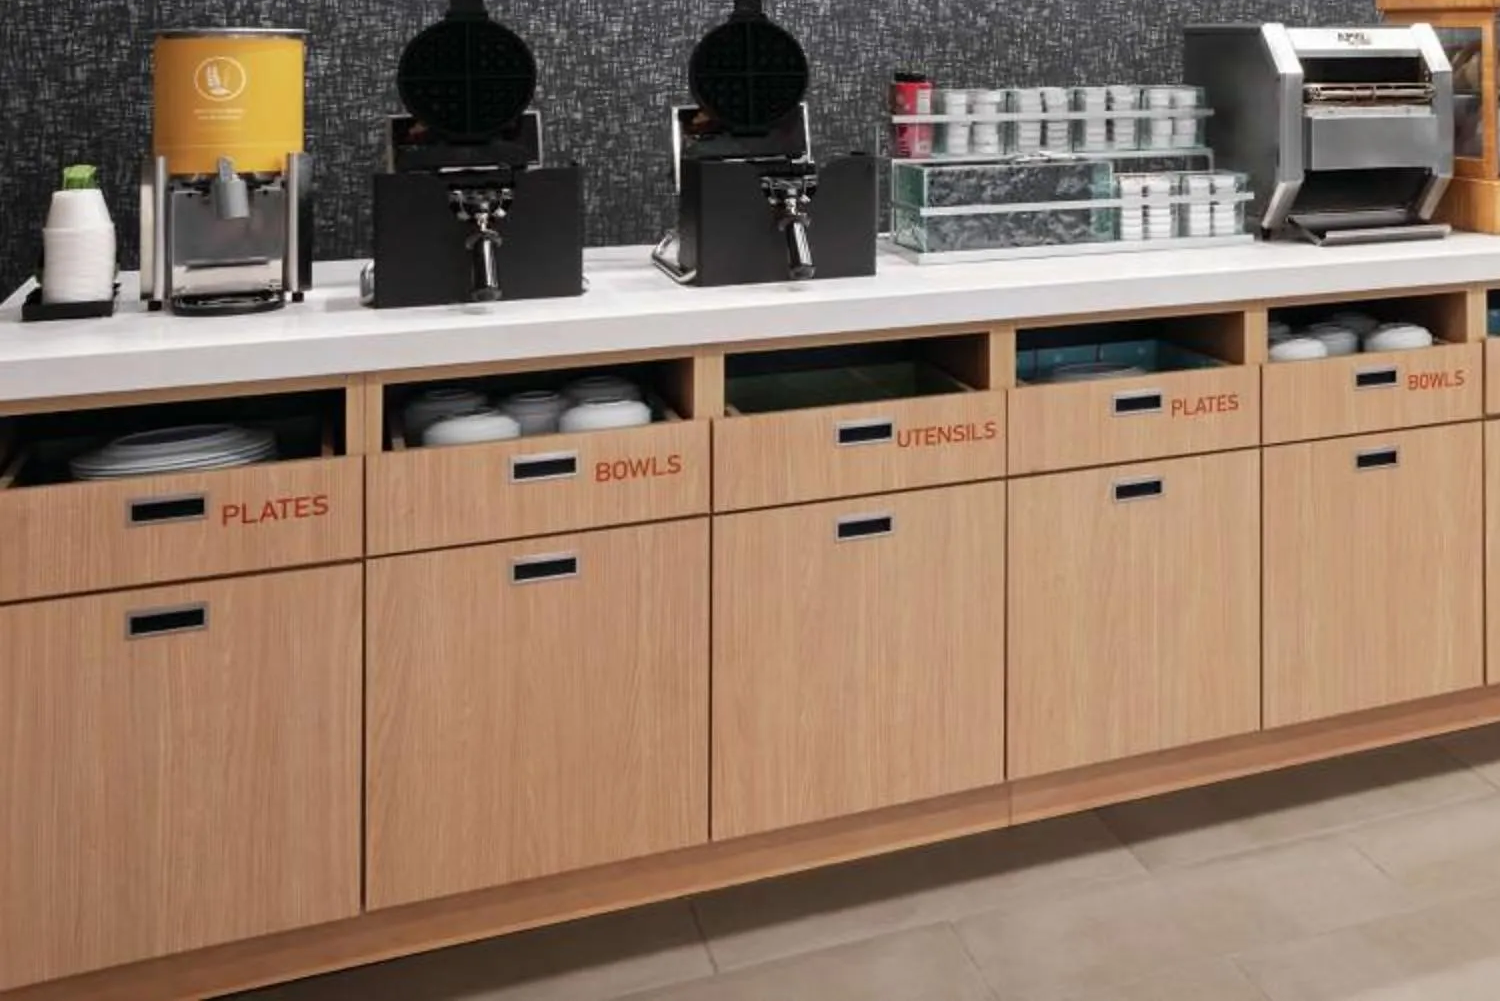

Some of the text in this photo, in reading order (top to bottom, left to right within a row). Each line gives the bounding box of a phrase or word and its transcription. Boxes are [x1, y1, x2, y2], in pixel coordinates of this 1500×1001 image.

[1407, 370, 1465, 391] BOWLS
[1170, 394, 1239, 418] PLATES
[896, 421, 997, 449] UTENSILS
[595, 454, 682, 482] BOWLS
[221, 494, 330, 527] PLATES
